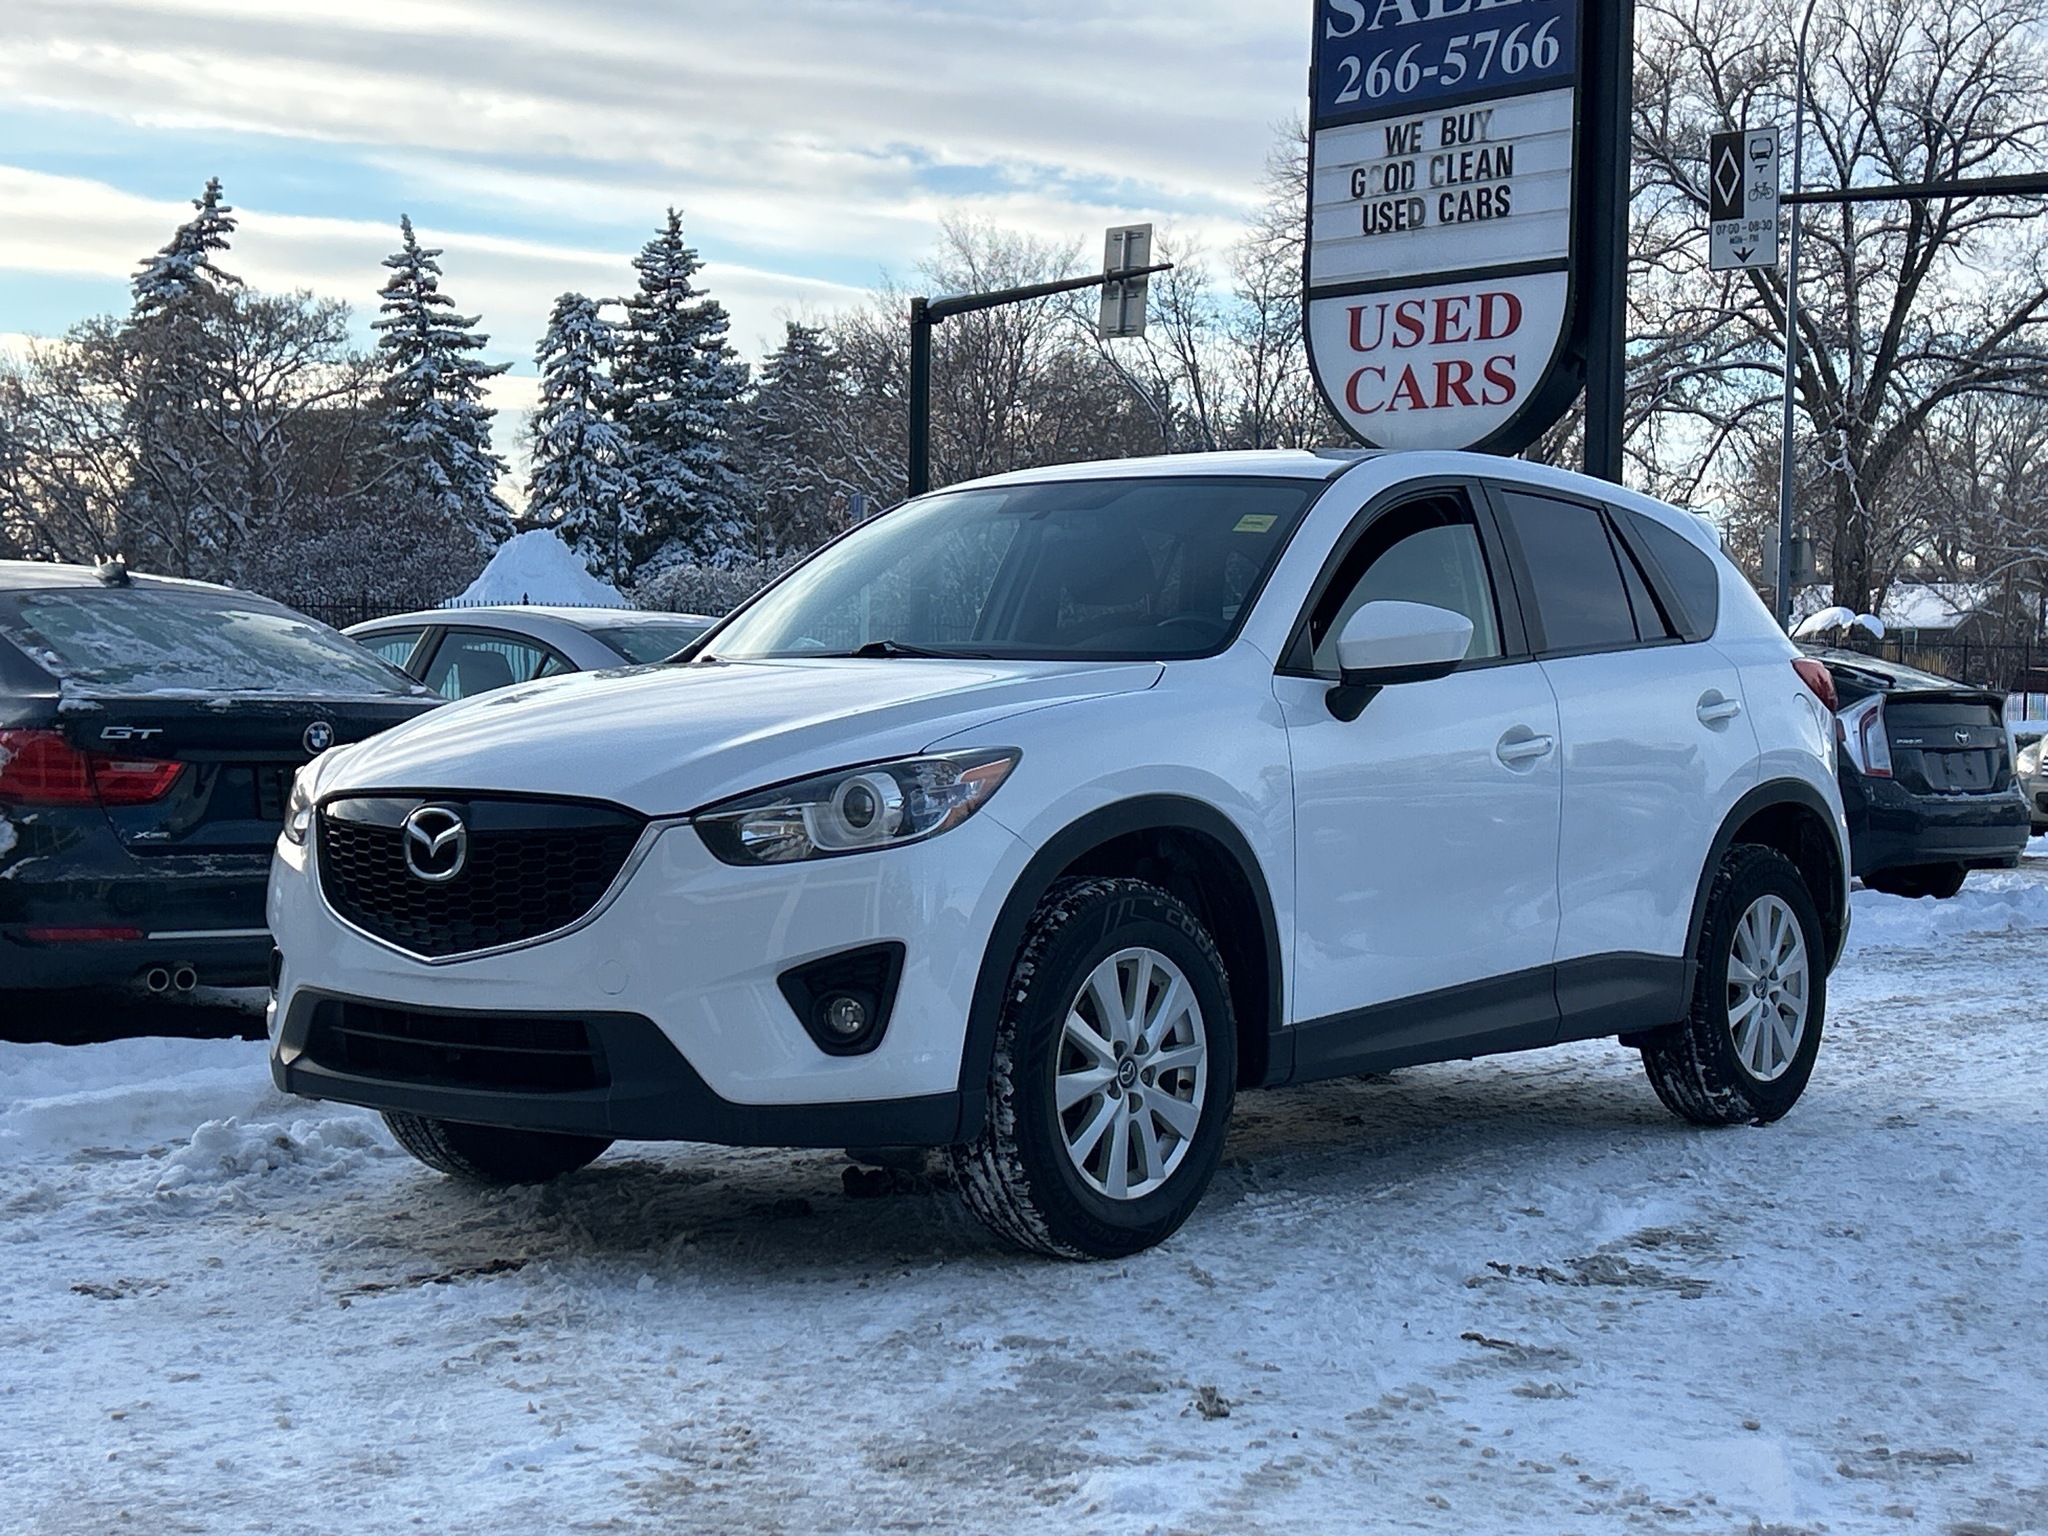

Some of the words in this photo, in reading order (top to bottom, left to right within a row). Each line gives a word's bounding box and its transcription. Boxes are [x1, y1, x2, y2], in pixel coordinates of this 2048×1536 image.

[1335, 16, 1561, 104] 266-5766
[1385, 121, 1423, 156] WE
[1441, 109, 1494, 146] BUY
[1430, 145, 1514, 187] CLEAN
[1363, 197, 1426, 235] USED
[1439, 185, 1511, 223] CARS
[1346, 292, 1522, 352] USED
[1345, 355, 1516, 415] CARS
[100, 726, 163, 740] GT
